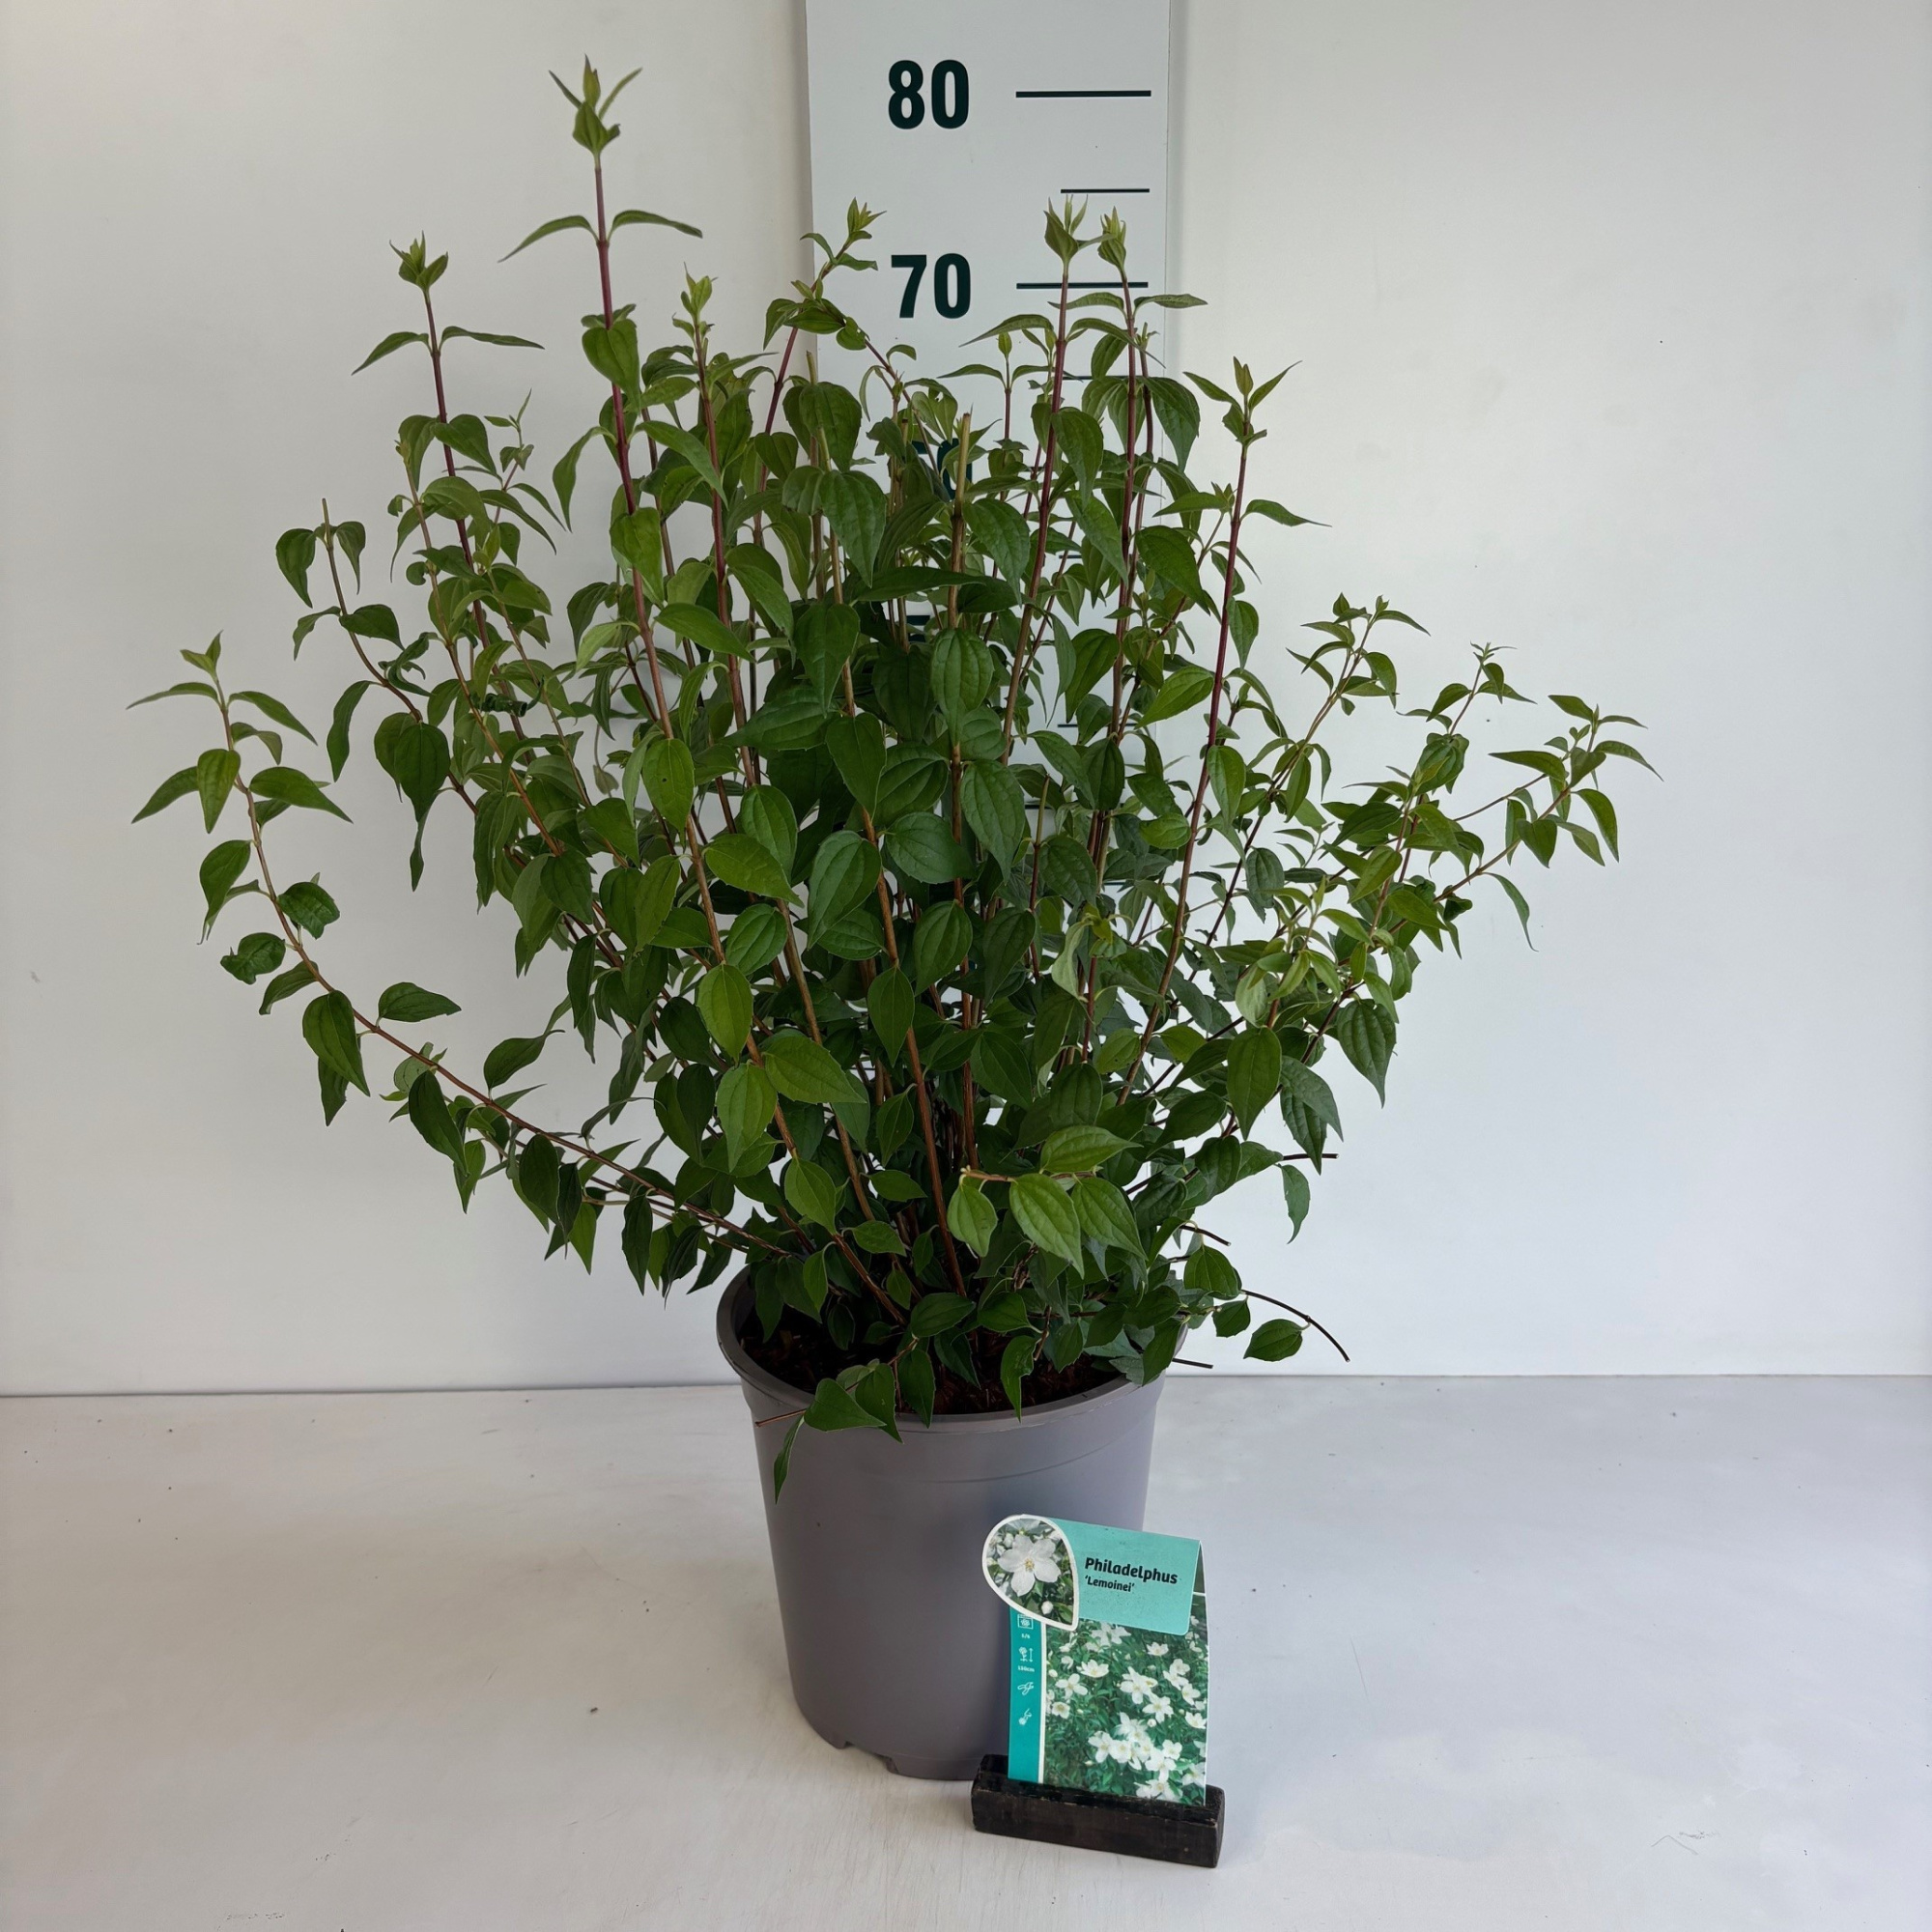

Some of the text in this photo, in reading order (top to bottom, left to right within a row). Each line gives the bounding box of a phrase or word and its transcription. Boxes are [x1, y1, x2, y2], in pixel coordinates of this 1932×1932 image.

[888, 59, 969, 129] 80
[891, 253, 971, 319] 70
[1085, 1557, 1179, 1584] Philadelphus
